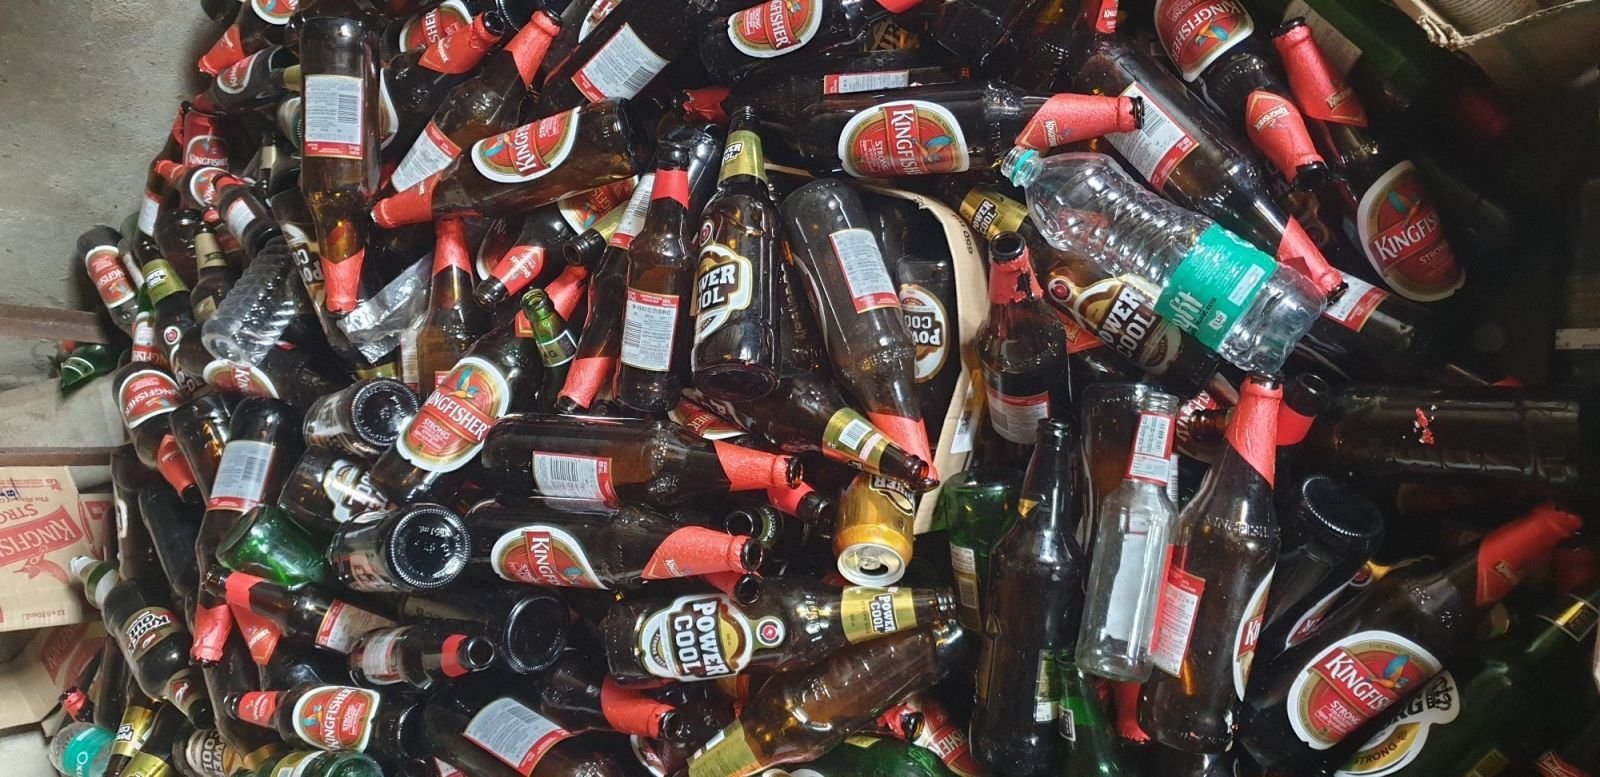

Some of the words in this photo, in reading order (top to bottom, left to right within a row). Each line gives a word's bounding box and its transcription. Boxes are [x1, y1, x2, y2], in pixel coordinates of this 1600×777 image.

[1104, 286, 1138, 346] OWER
[1116, 312, 1157, 359] COOL
[421, 417, 451, 438] STRONG
[870, 602, 884, 632] COOL
[878, 595, 897, 632] POWER
[674, 615, 702, 674] COOL
[693, 600, 730, 676] POWER
[1329, 699, 1362, 725] STRONG
